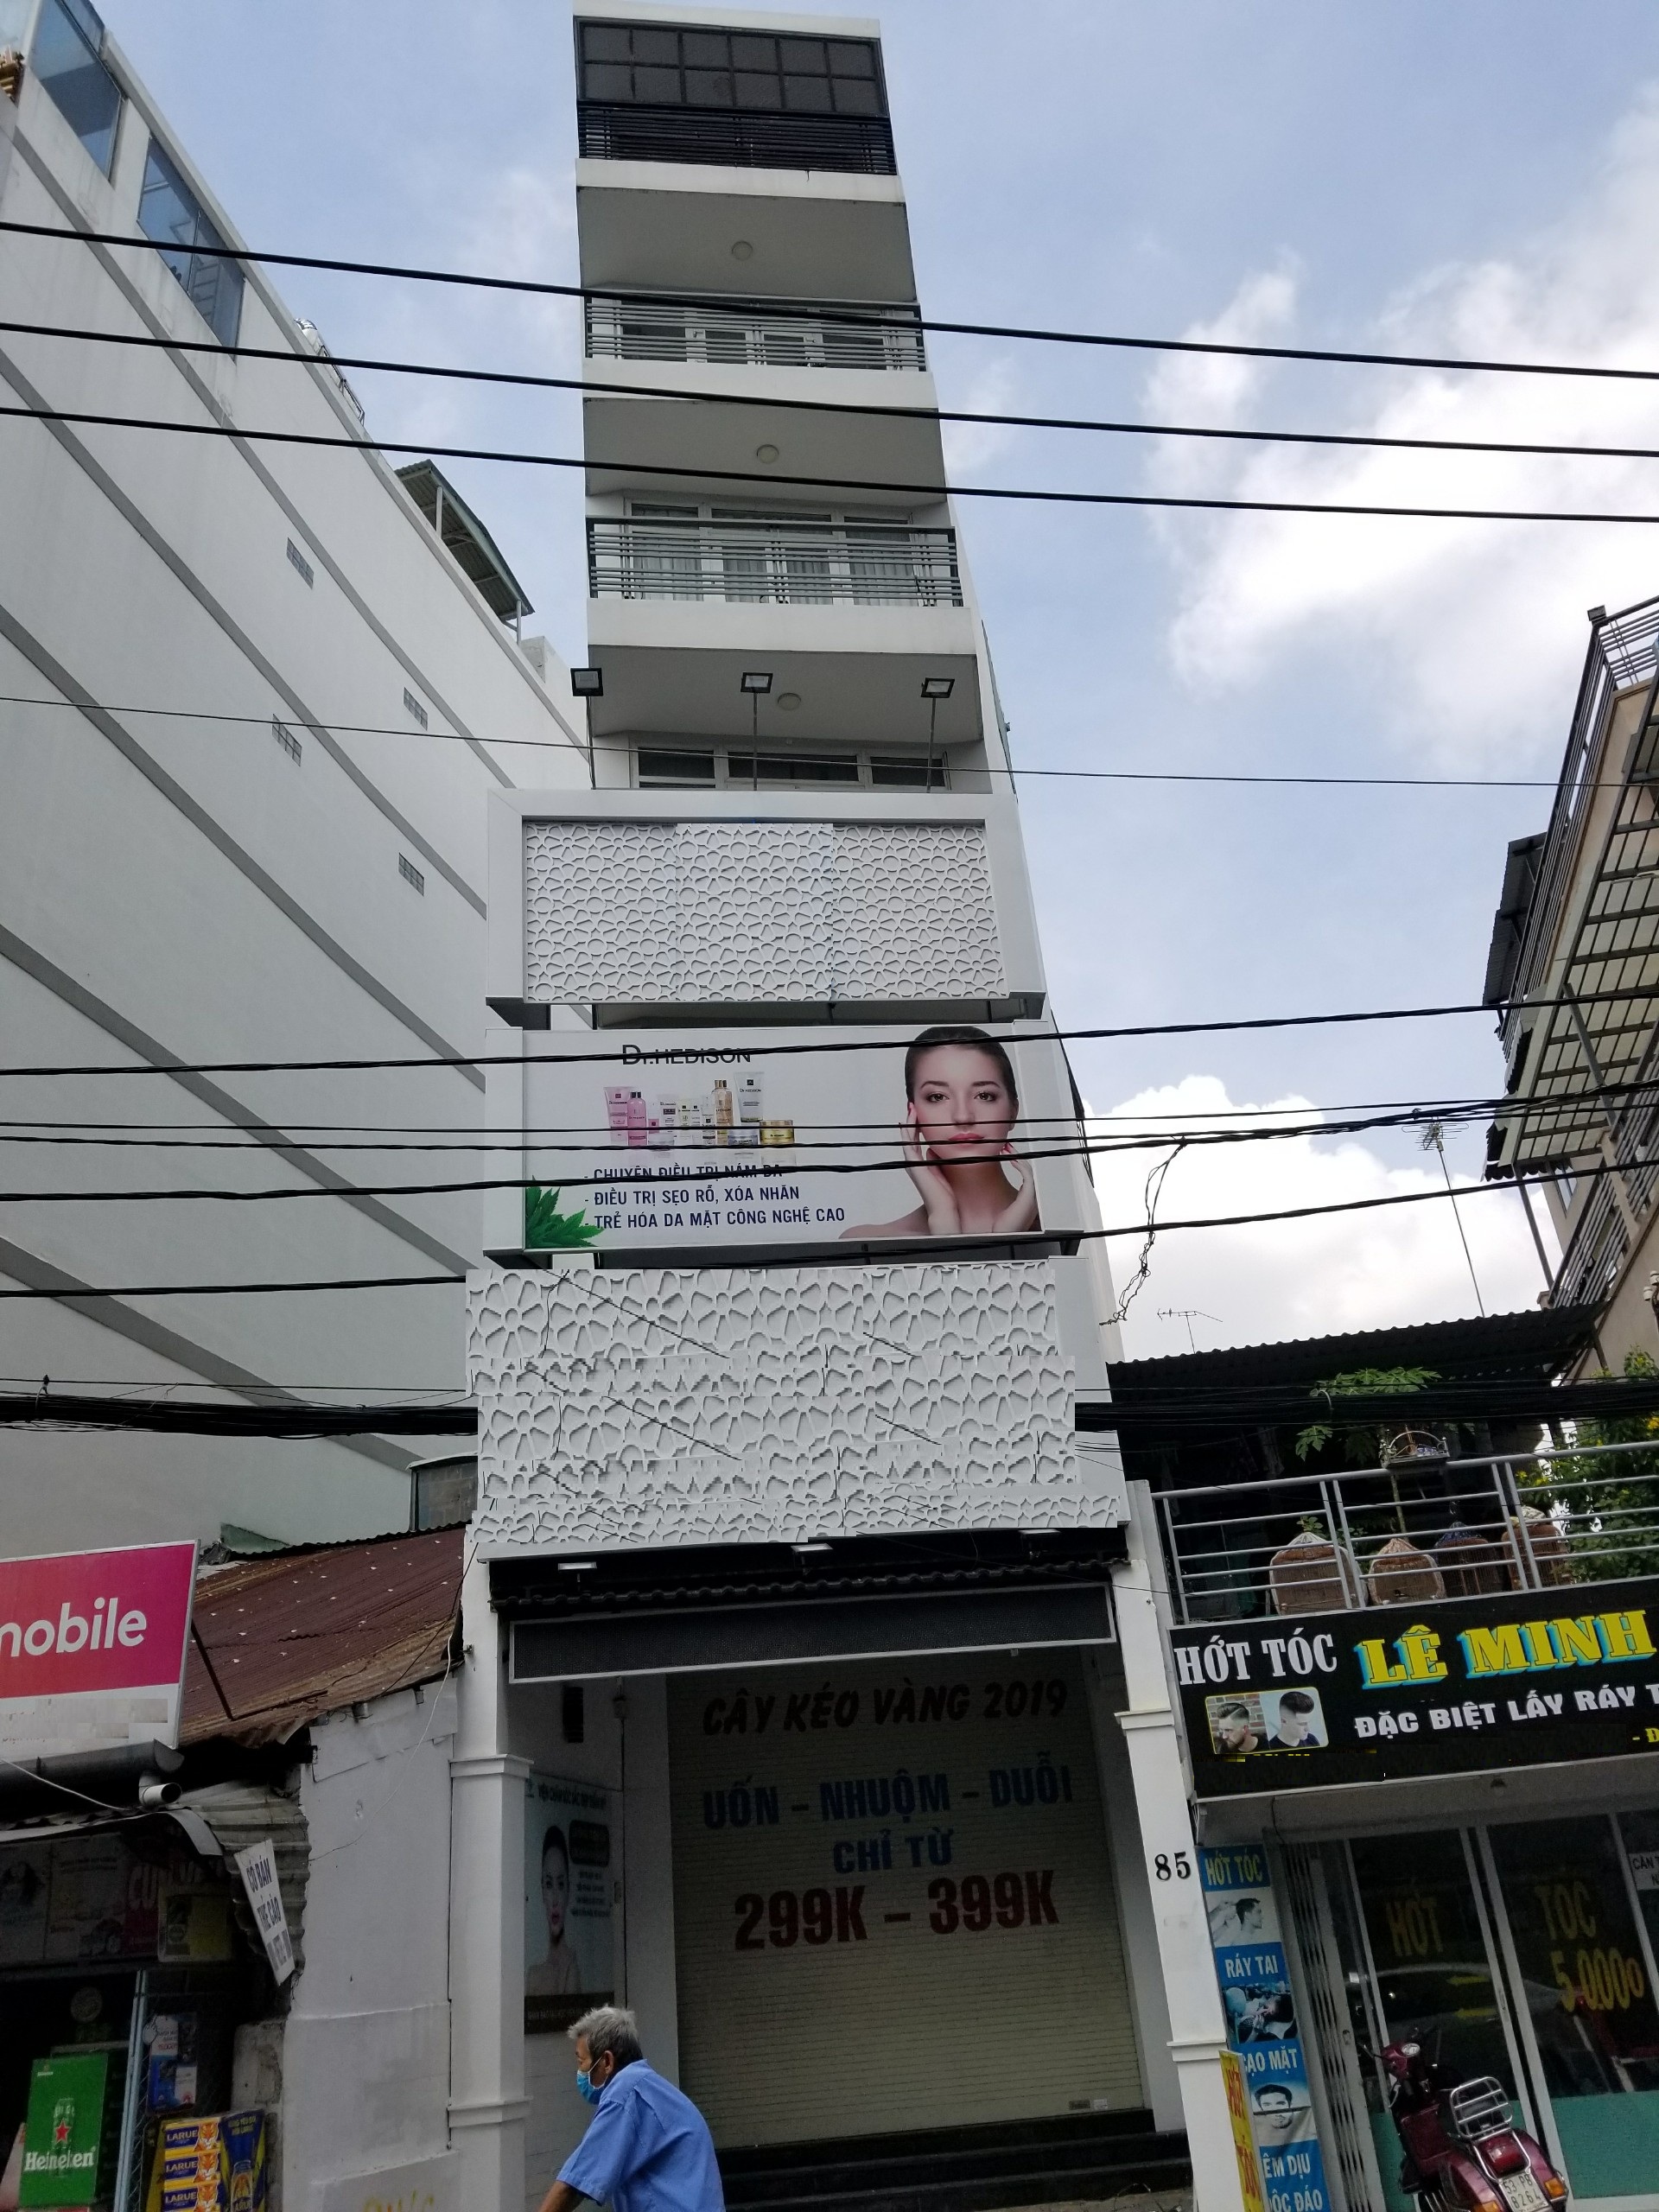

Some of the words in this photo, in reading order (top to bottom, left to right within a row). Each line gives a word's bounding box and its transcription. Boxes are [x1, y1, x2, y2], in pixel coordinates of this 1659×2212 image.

[594, 1166, 652, 1180] CHUYÊN
[658, 1162, 690, 1179] ĐIỀU
[594, 1187, 627, 1205] ĐIỀU
[633, 1190, 657, 1206] TRỊ
[662, 1189, 690, 1205] SẸO
[724, 1185, 754, 1202] XÓA
[760, 1185, 799, 1200] NHĂN
[594, 1211, 621, 1229] TRẺ
[628, 1211, 658, 1228] HÓA
[664, 1213, 684, 1227] DA
[690, 1210, 721, 1229] MẶT
[727, 1208, 766, 1224] CÔNG
[772, 1206, 810, 1224] NGHỆ
[816, 1207, 845, 1222] CAO
[1173, 1635, 1250, 1685] HỚT
[1261, 1628, 1337, 1677] TÓC
[1353, 1624, 1448, 1689] LÊ
[1457, 1610, 1657, 1679] MINH
[703, 1688, 775, 1735] CÂY
[784, 1681, 860, 1732] KÉO
[873, 1677, 970, 1724] VÀNG
[983, 1679, 1068, 1718] 2019
[1354, 1710, 1419, 1738] ĐẶC
[1429, 1701, 1496, 1730] BIỆT
[1507, 1689, 1563, 1720] LẤY
[1573, 1684, 1635, 1711] RÁY
[703, 1776, 779, 1828] UỐN
[819, 1768, 950, 1822] NHUỘM
[989, 1751, 1072, 1807] DUỖI
[833, 1828, 892, 1873] CHỈ
[906, 1826, 953, 1866] TỪ
[255, 1855, 272, 1888] BÁN
[1154, 1852, 1191, 1881] 85
[1205, 1851, 1231, 1885] HỚT
[1236, 1847, 1263, 1883] TÓC
[734, 1885, 868, 1949] 299K
[928, 1870, 1058, 1934] 399K
[1224, 1953, 1252, 1978] RÁY
[1255, 1955, 1279, 1975] TAI
[1268, 2045, 1298, 2075] MẶT
[167, 2130, 198, 2141] LARUE
[23, 2150, 94, 2172] Heineken
[166, 2161, 197, 2172] LARUE
[1287, 2152, 1311, 2180] DỊU
[165, 2192, 197, 2203] LARUE
[1294, 2184, 1323, 2212] ĐÁO
